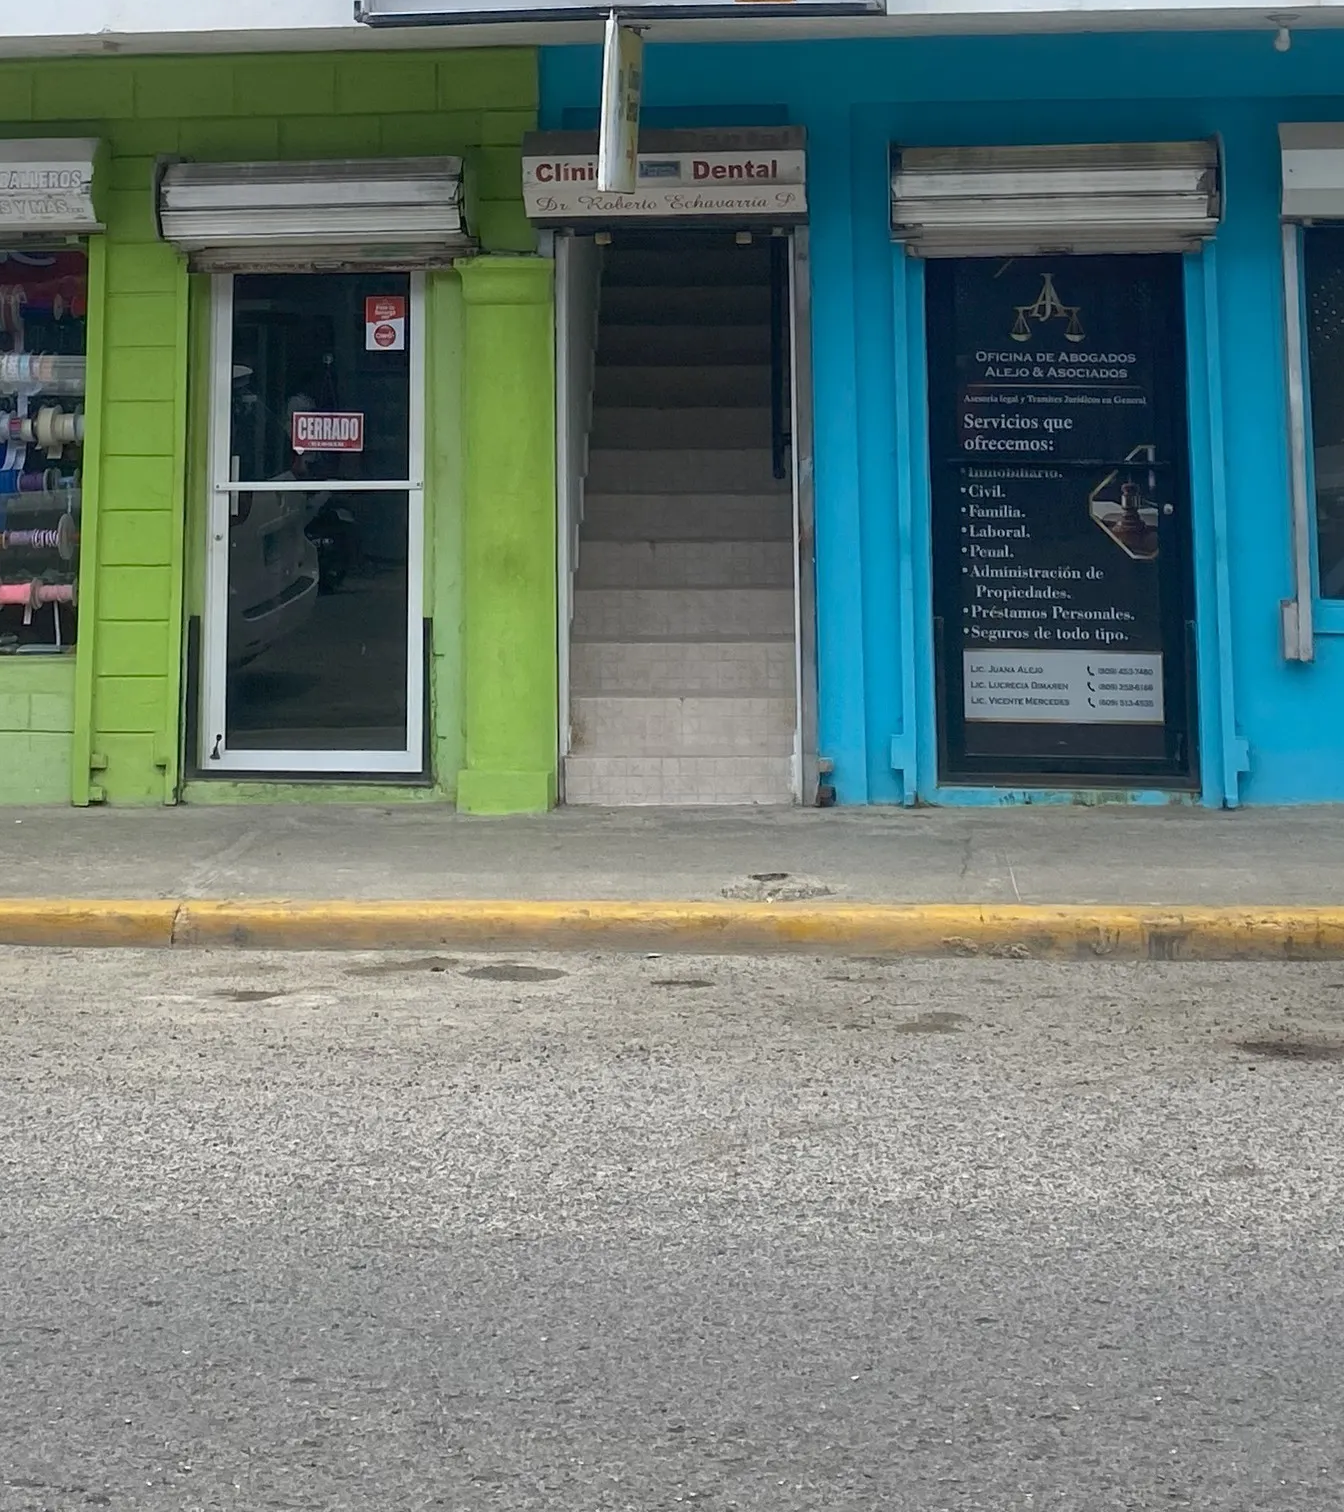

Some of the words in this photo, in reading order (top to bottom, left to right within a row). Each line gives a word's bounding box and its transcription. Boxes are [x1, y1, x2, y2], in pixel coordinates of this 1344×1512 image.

[535, 162, 599, 183] Clíni
[692, 159, 777, 180] Dental
[976, 351, 1032, 363] OFICINA
[1036, 352, 1054, 363] DE
[1058, 351, 1136, 364] ABOGADOS
[985, 366, 1029, 378] ALEJO
[1033, 366, 1044, 378] &
[1047, 366, 1128, 379] ASOCIADOS
[297, 416, 359, 441] CERRADO
[963, 413, 1038, 430] Servicios
[1044, 416, 1073, 433] que
[964, 435, 1055, 452] ofrecemos:
[968, 484, 1006, 498] Civil.
[969, 504, 1026, 518] Familia.
[970, 524, 1030, 538] Laboral.
[970, 545, 1014, 559] Penal.
[971, 565, 1081, 580] Administración
[1086, 566, 1104, 579] de
[976, 585, 1071, 601] Propiedades.
[1052, 606, 1135, 621] Personales.
[971, 627, 1029, 643] Seguros
[1034, 626, 1051, 640] de
[1056, 627, 1090, 640] todo
[1095, 627, 1129, 644] tipo.
